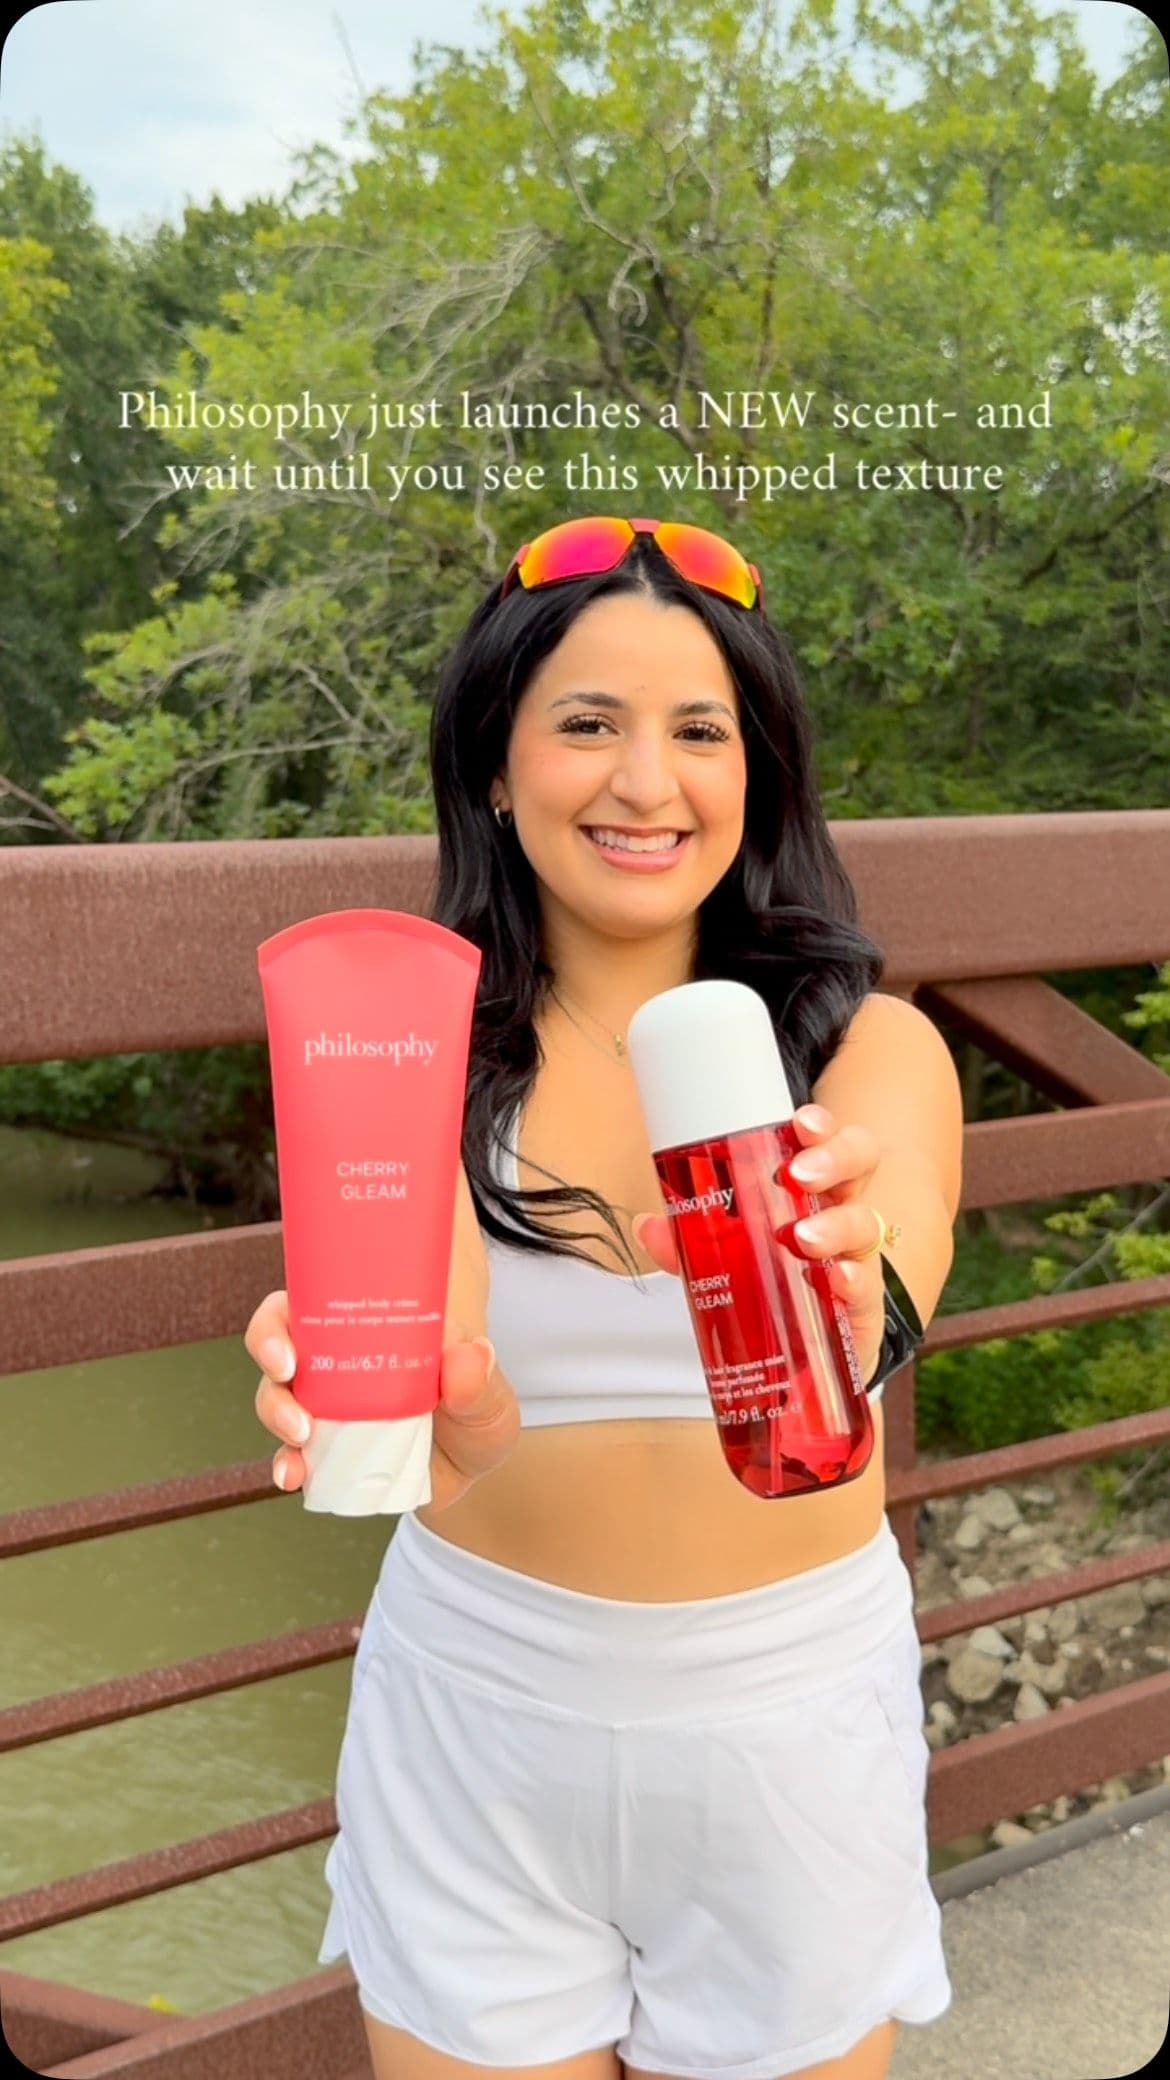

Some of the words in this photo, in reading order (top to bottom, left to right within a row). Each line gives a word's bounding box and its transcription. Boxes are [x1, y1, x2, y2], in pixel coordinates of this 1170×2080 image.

[303, 1031, 439, 1067] philosophy
[336, 1160, 410, 1178] CHERRY
[340, 1183, 408, 1201] GLEAM
[310, 1354, 335, 1370] 200
